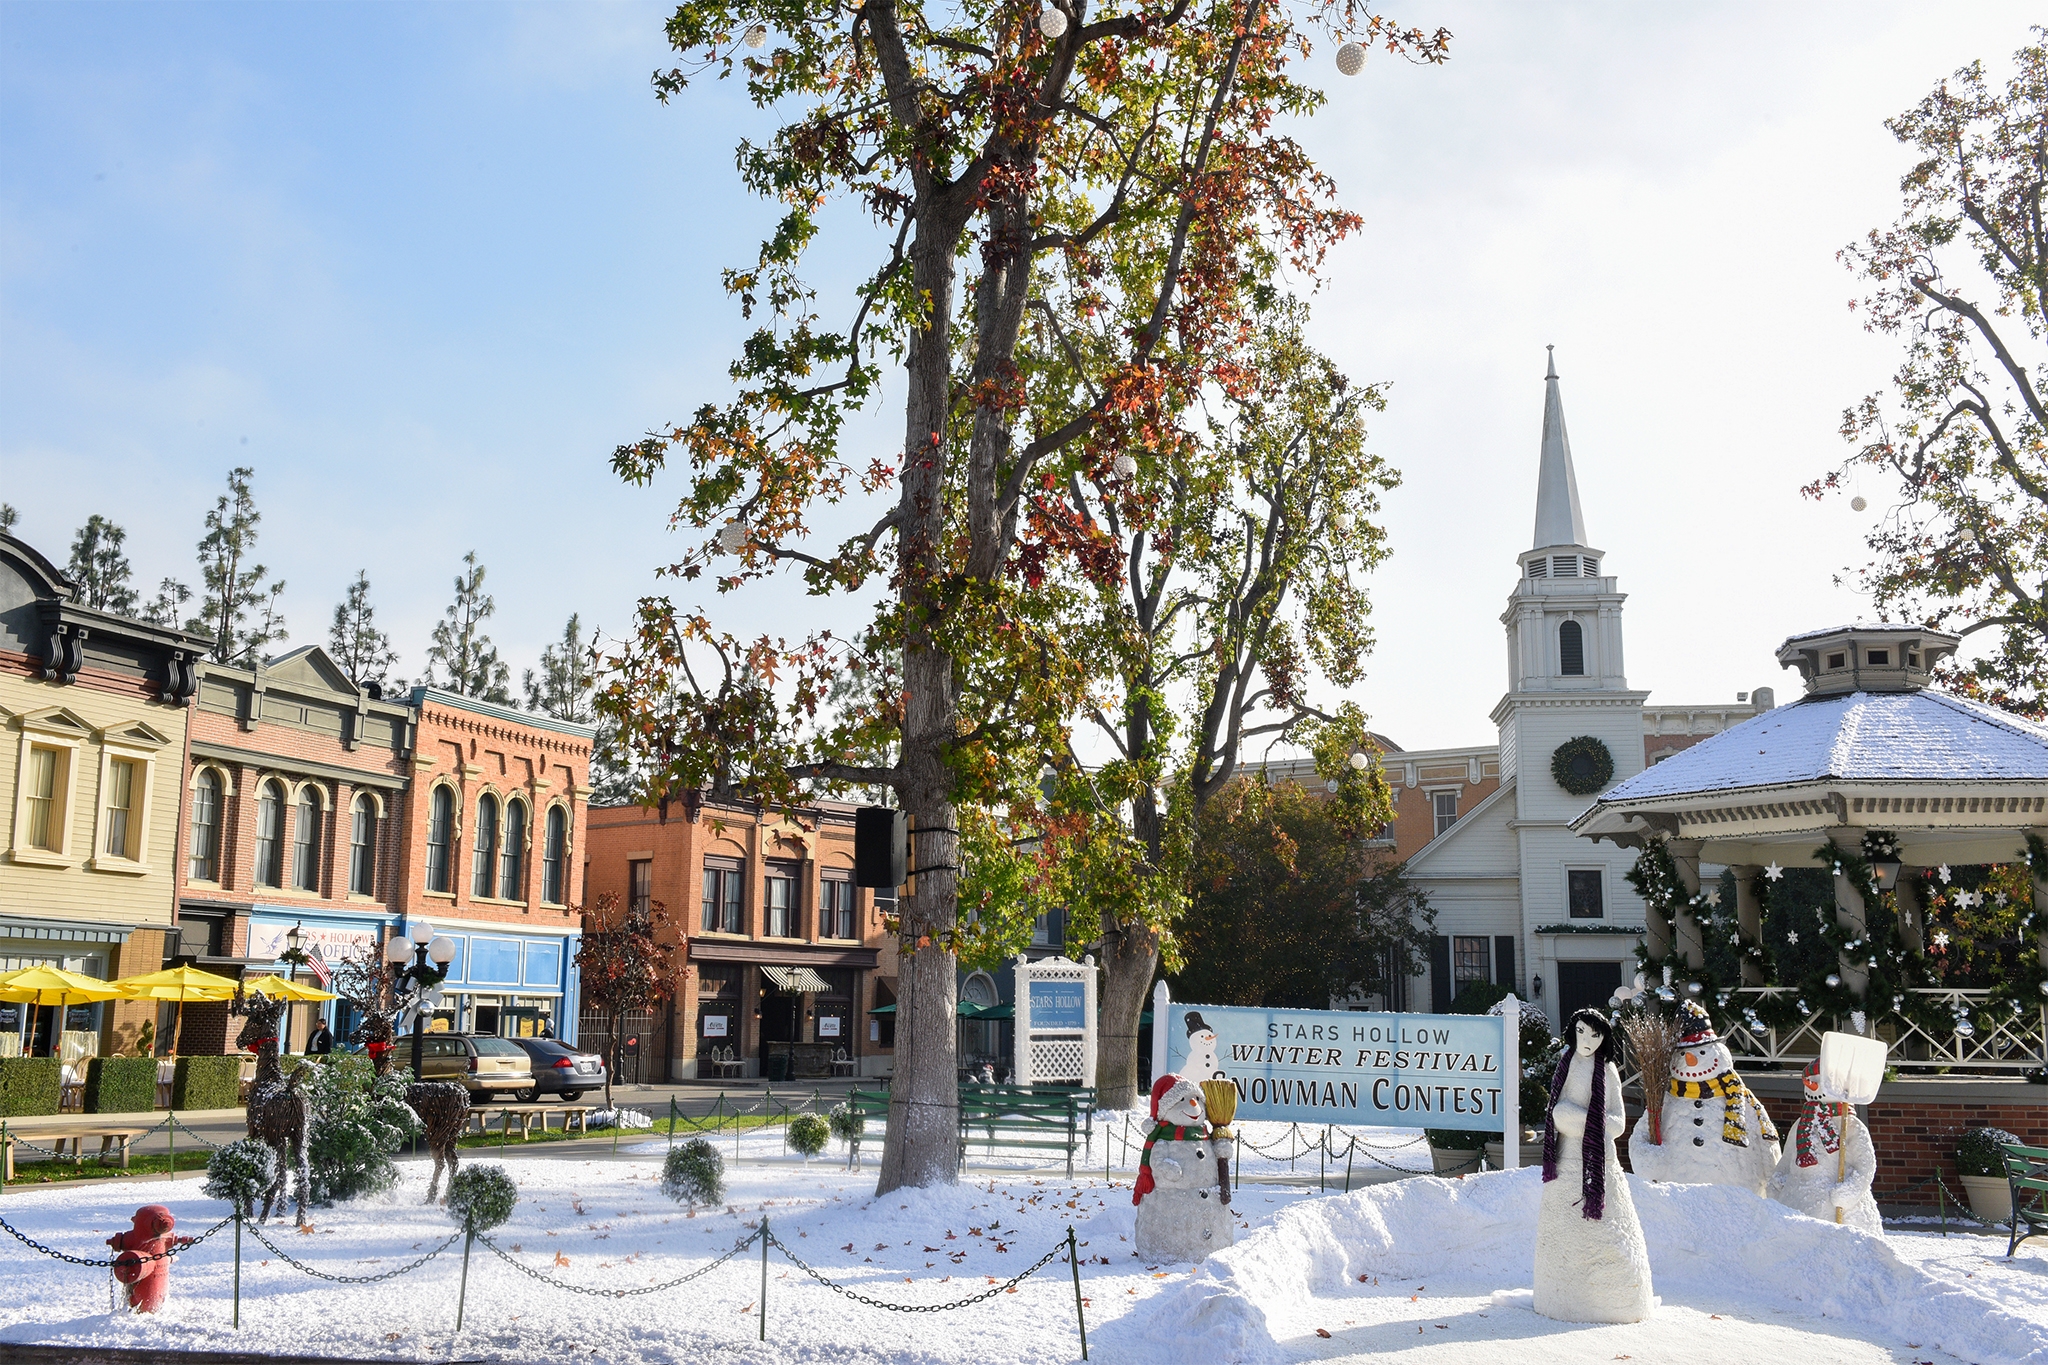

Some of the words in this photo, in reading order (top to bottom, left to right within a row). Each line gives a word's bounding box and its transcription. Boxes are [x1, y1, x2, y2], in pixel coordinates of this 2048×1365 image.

[330, 933, 370, 944] HOLLOW
[323, 943, 369, 959] OFFICE
[1031, 995, 1054, 1008] STARS
[1055, 996, 1081, 1008] HOLLOW
[1267, 1022, 1339, 1041] STARS
[1353, 1026, 1450, 1045] HOLLOW
[1231, 1044, 1343, 1067] WINTER
[1355, 1049, 1499, 1073] FESTIVAL
